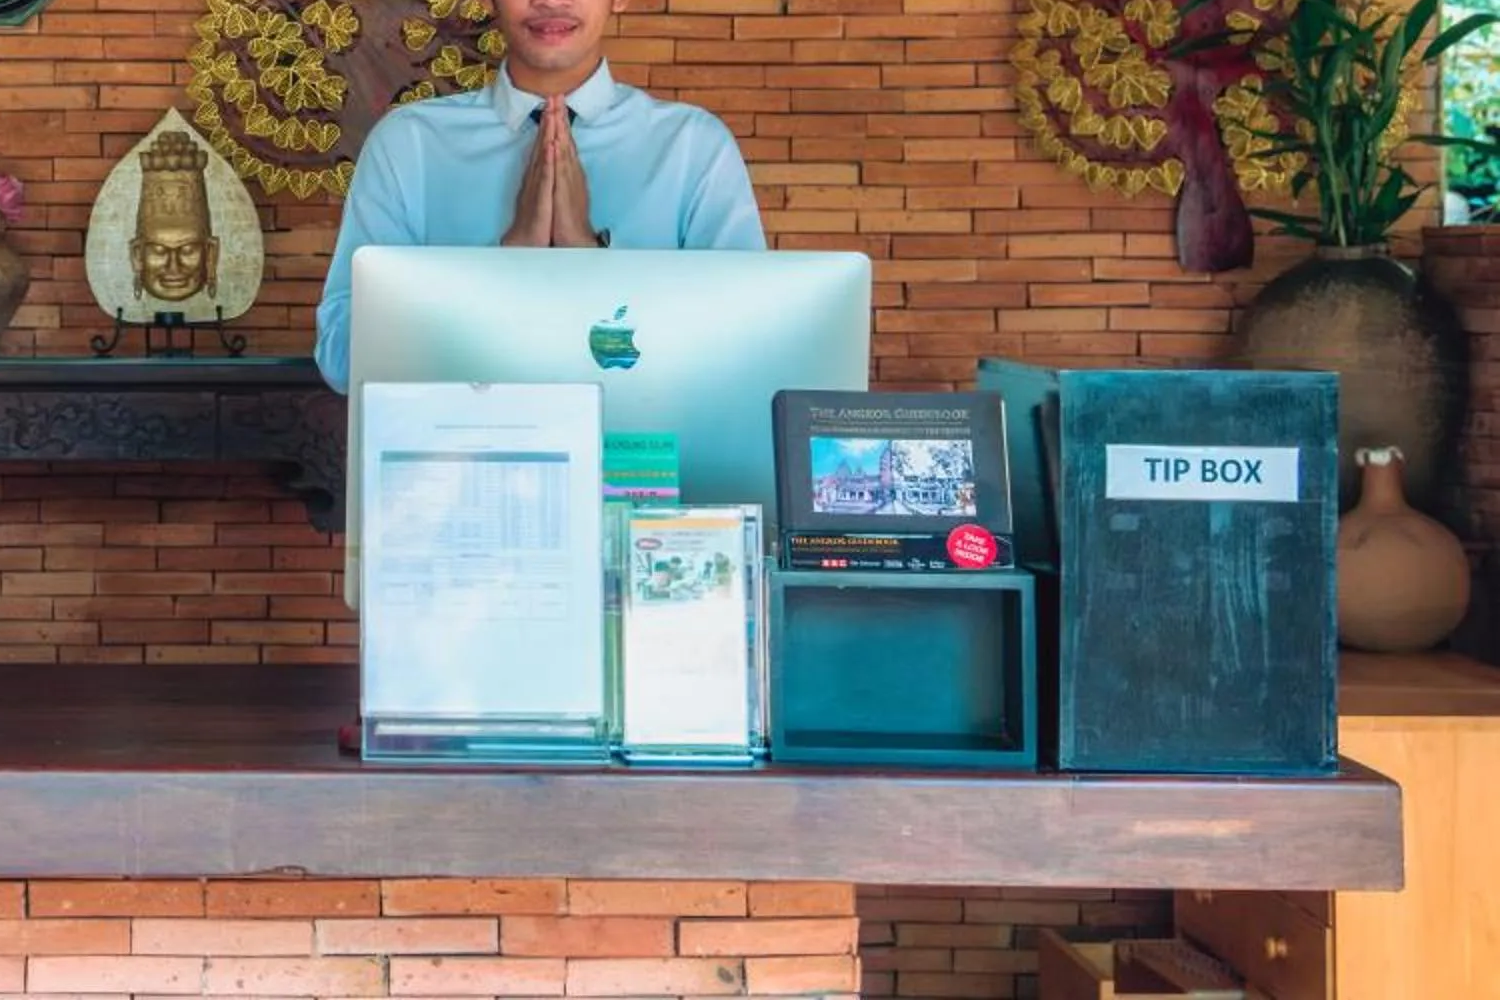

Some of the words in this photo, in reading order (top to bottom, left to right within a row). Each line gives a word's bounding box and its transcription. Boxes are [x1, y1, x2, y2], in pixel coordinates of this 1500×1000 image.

[838, 406, 891, 421] ANGKOR
[894, 406, 970, 421] GUIDEBOOK
[1144, 457, 1190, 483] TIP
[1201, 459, 1263, 484] BOX
